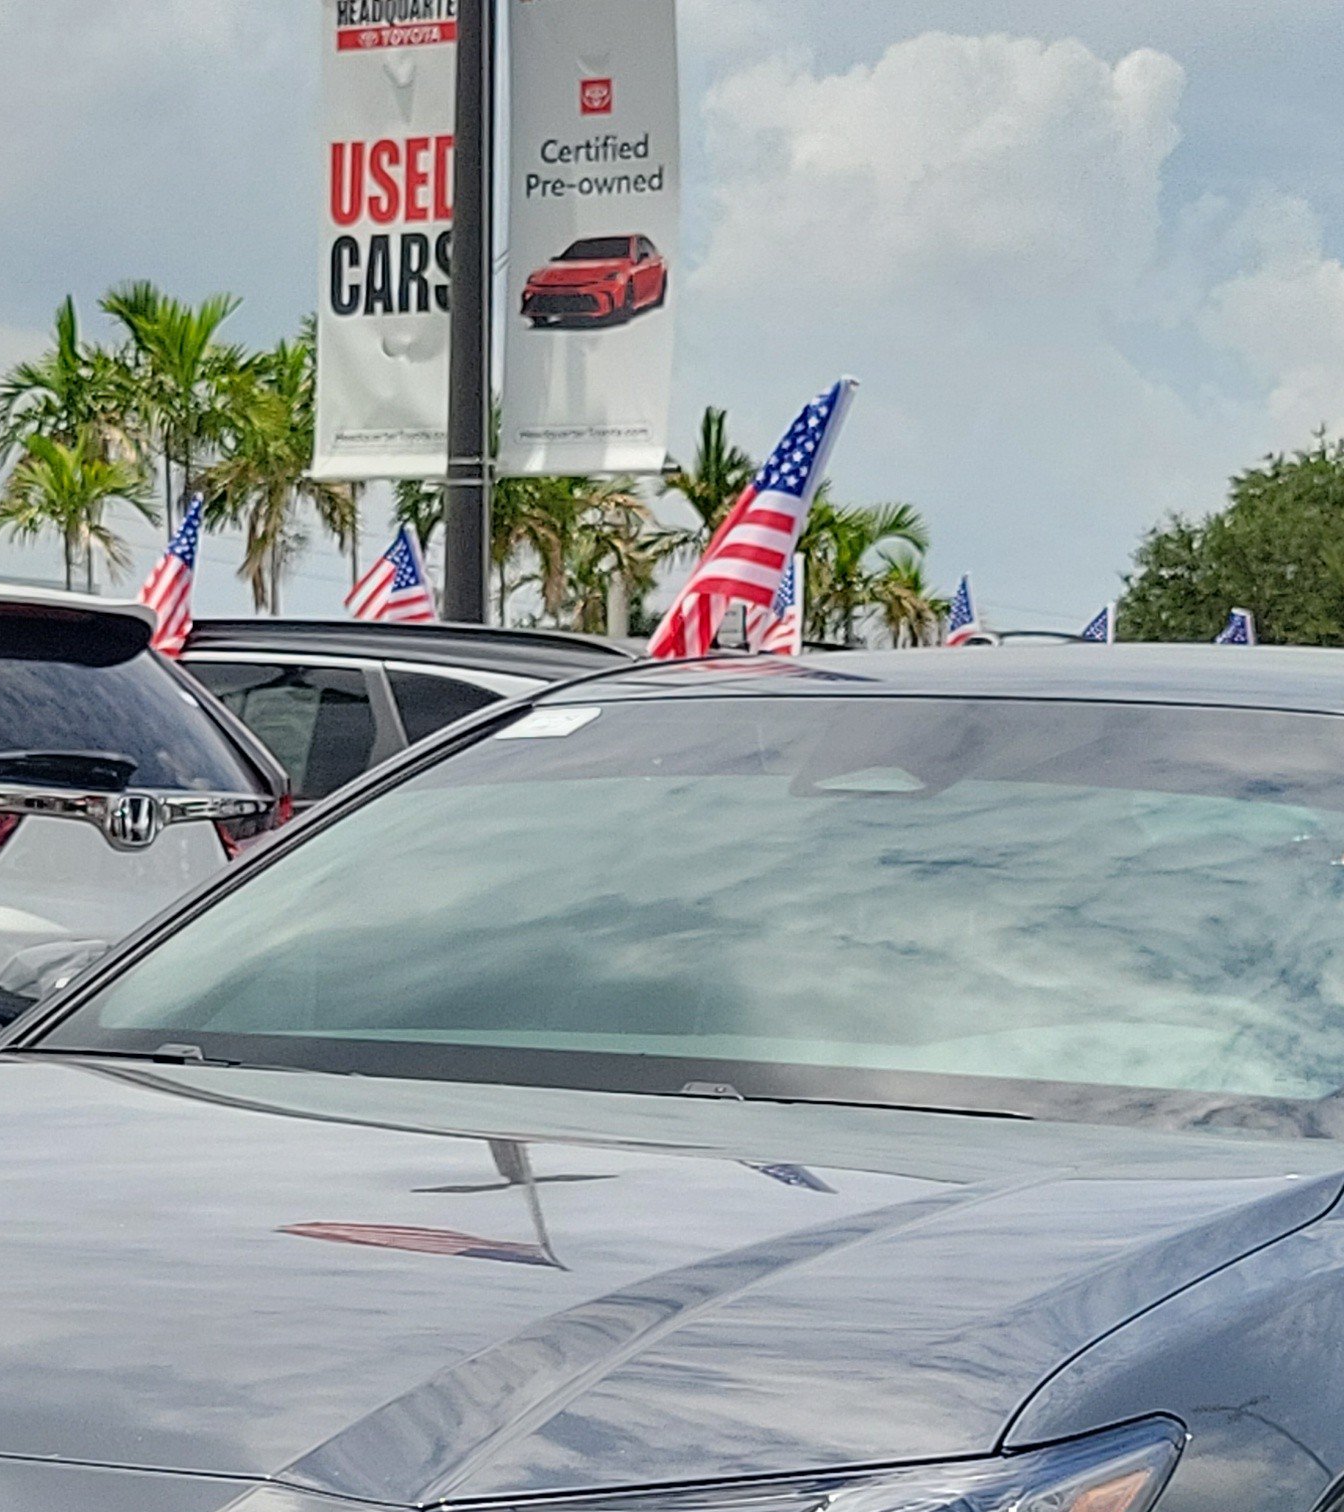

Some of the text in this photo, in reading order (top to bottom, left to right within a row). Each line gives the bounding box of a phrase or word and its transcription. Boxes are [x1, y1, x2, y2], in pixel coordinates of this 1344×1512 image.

[381, 27, 440, 46] TOYOTA
[540, 133, 649, 164] Certified
[330, 136, 454, 226] USED
[526, 165, 663, 198] Pre-owned
